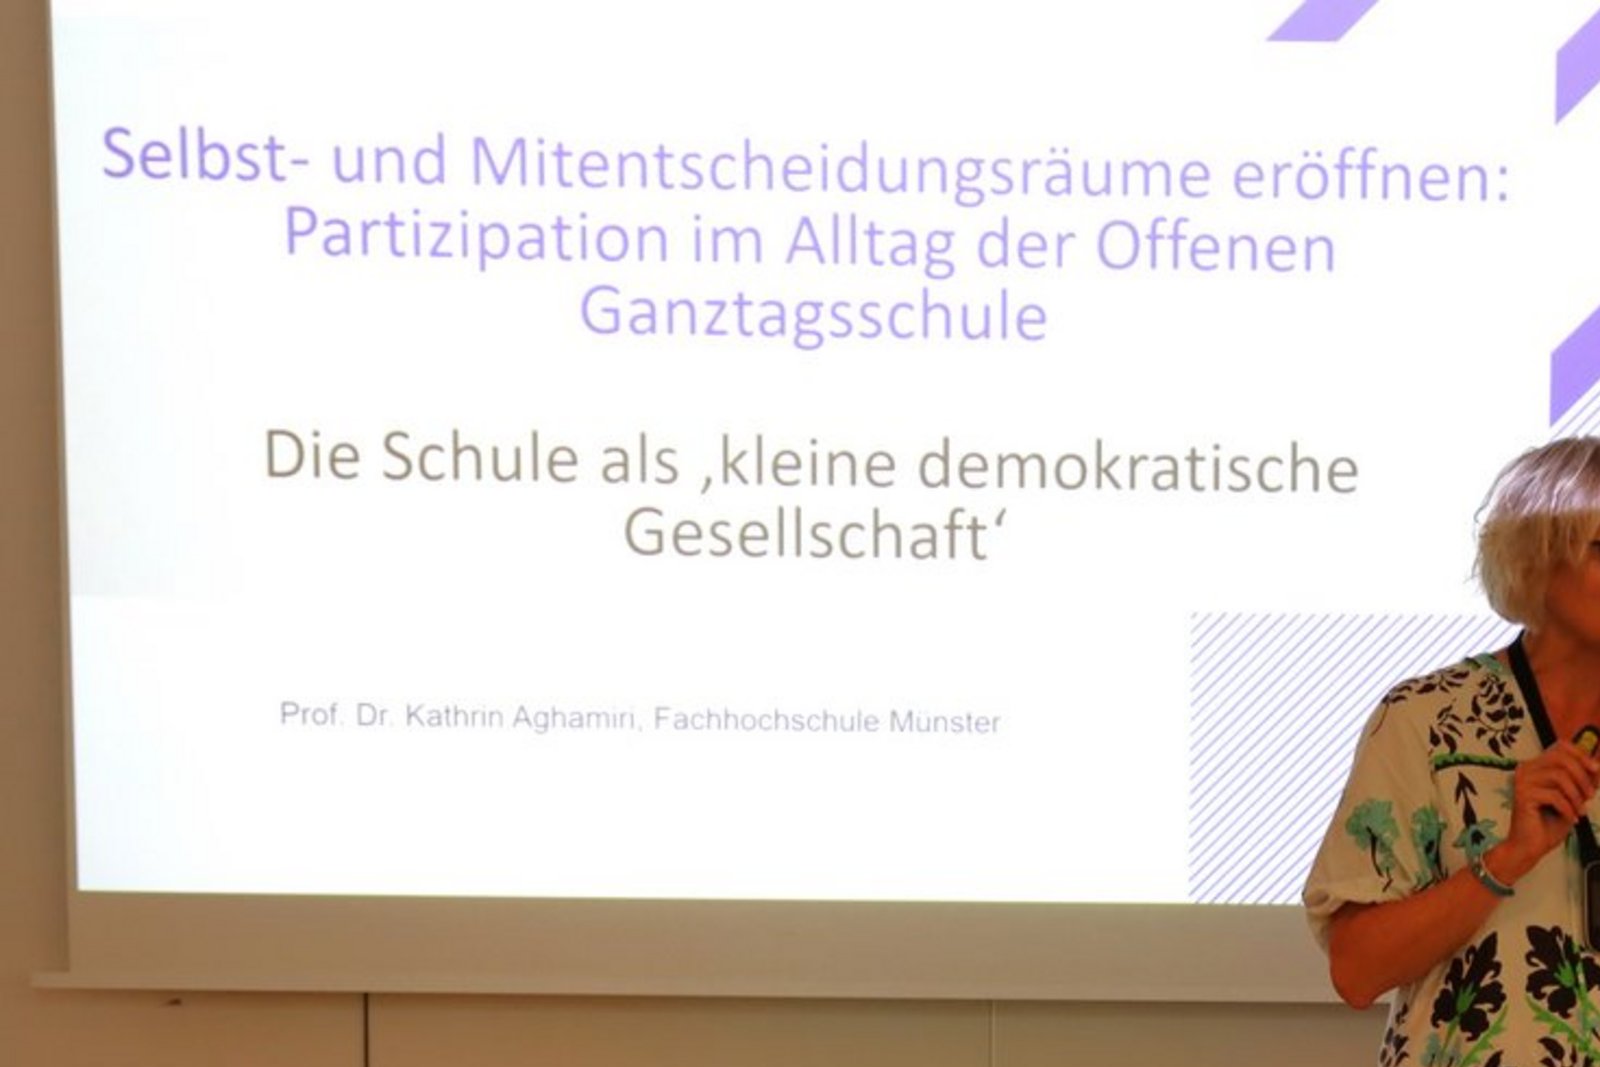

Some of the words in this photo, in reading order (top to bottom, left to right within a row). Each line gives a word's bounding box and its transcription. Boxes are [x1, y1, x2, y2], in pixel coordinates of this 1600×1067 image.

[103, 125, 309, 183] Selbst-
[333, 132, 445, 185] und
[473, 136, 1211, 208] Mitentscheidungsräume
[1233, 145, 1507, 202] eröffnen:
[286, 205, 667, 273] Partizipation
[694, 214, 762, 263] im
[786, 213, 955, 280] Alltag
[978, 215, 1076, 269] der
[1097, 216, 1334, 273] Offenen
[581, 284, 1047, 351] Ganztagsschule
[265, 428, 361, 481] Die
[382, 428, 579, 484] Schule
[601, 431, 679, 485] als
[918, 435, 1359, 494] demokratische
[279, 700, 344, 727] Prof.
[356, 701, 393, 727] Dr.
[405, 703, 504, 728] Kathrin
[654, 705, 881, 733] Fachhochschule
